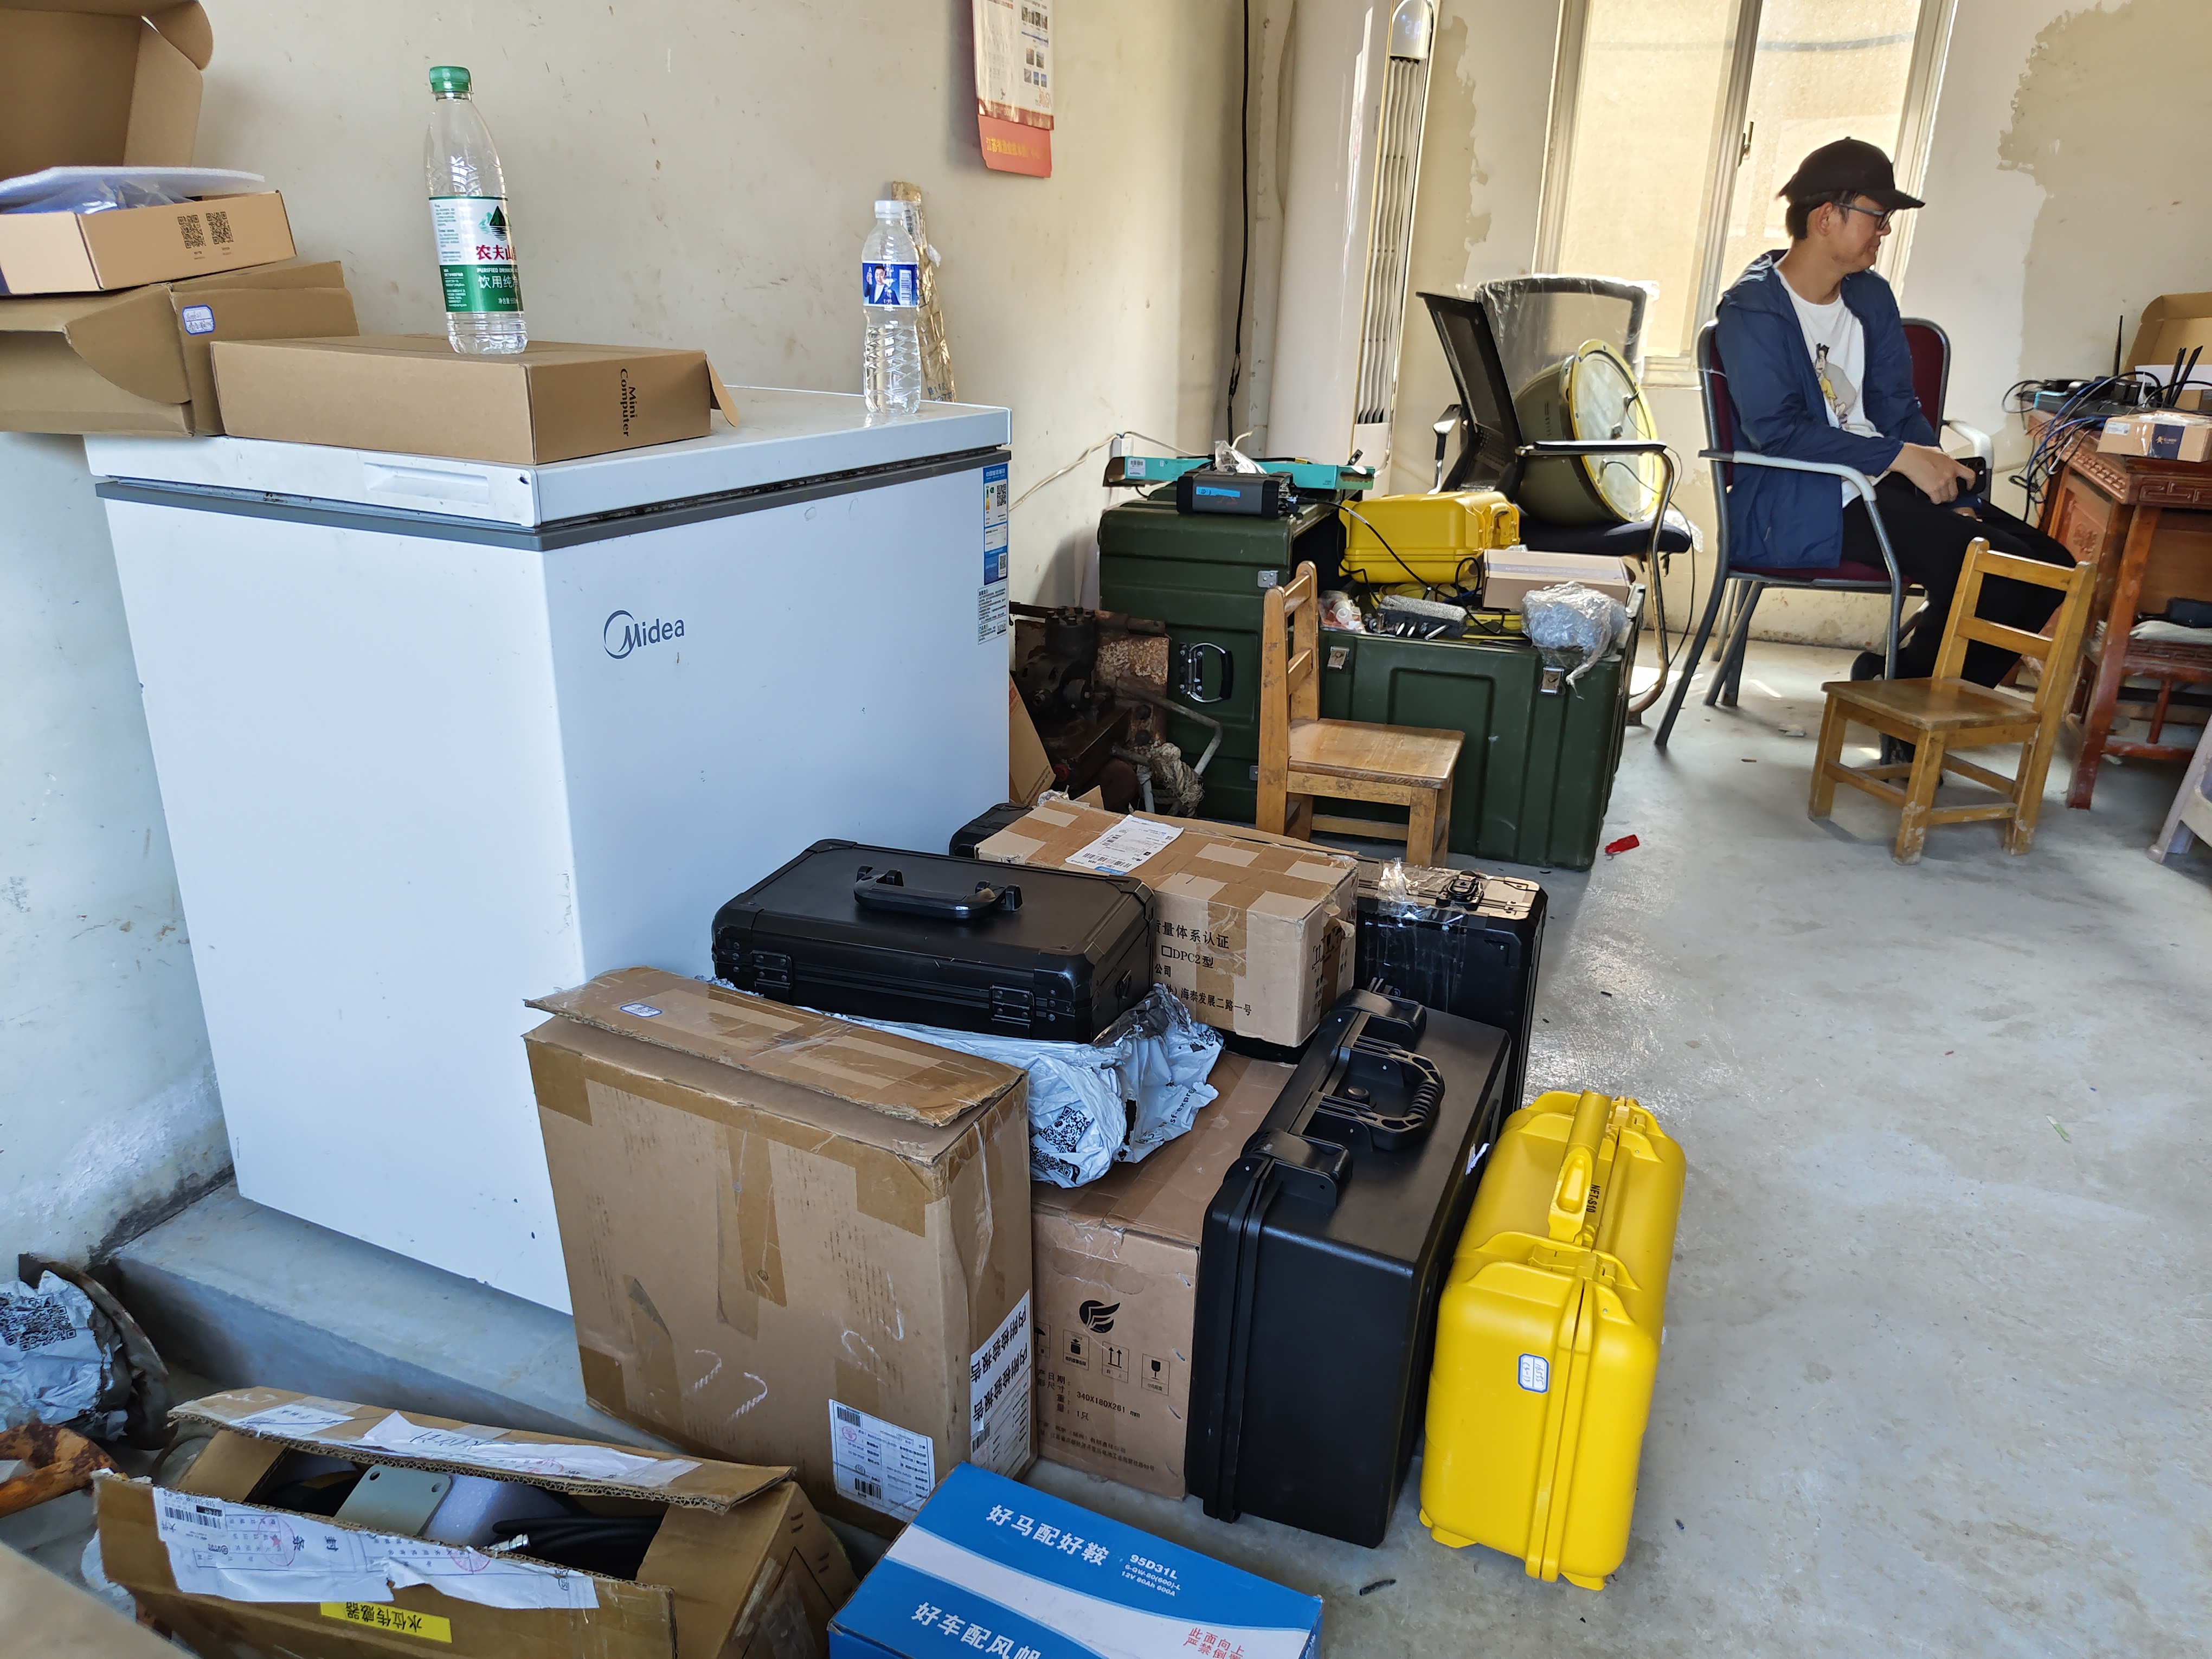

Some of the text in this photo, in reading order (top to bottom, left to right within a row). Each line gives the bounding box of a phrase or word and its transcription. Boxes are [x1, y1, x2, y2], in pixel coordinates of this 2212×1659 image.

[620, 369, 629, 436] Computer
[629, 387, 638, 418] Mini
[607, 613, 685, 656] Midea
[1155, 963, 1171, 977] 公司
[971, 1304, 1026, 1383] 内附检验报告
[973, 1342, 1027, 1422] 内附检验报告
[986, 1504, 1110, 1566] 好马配好鞍
[1130, 1554, 1177, 1580] 95D31L
[1122, 1571, 1175, 1597] 12V 80Ah 600A
[345, 1602, 422, 1632] 水位传感器
[1188, 1627, 1244, 1655] 此面向上
